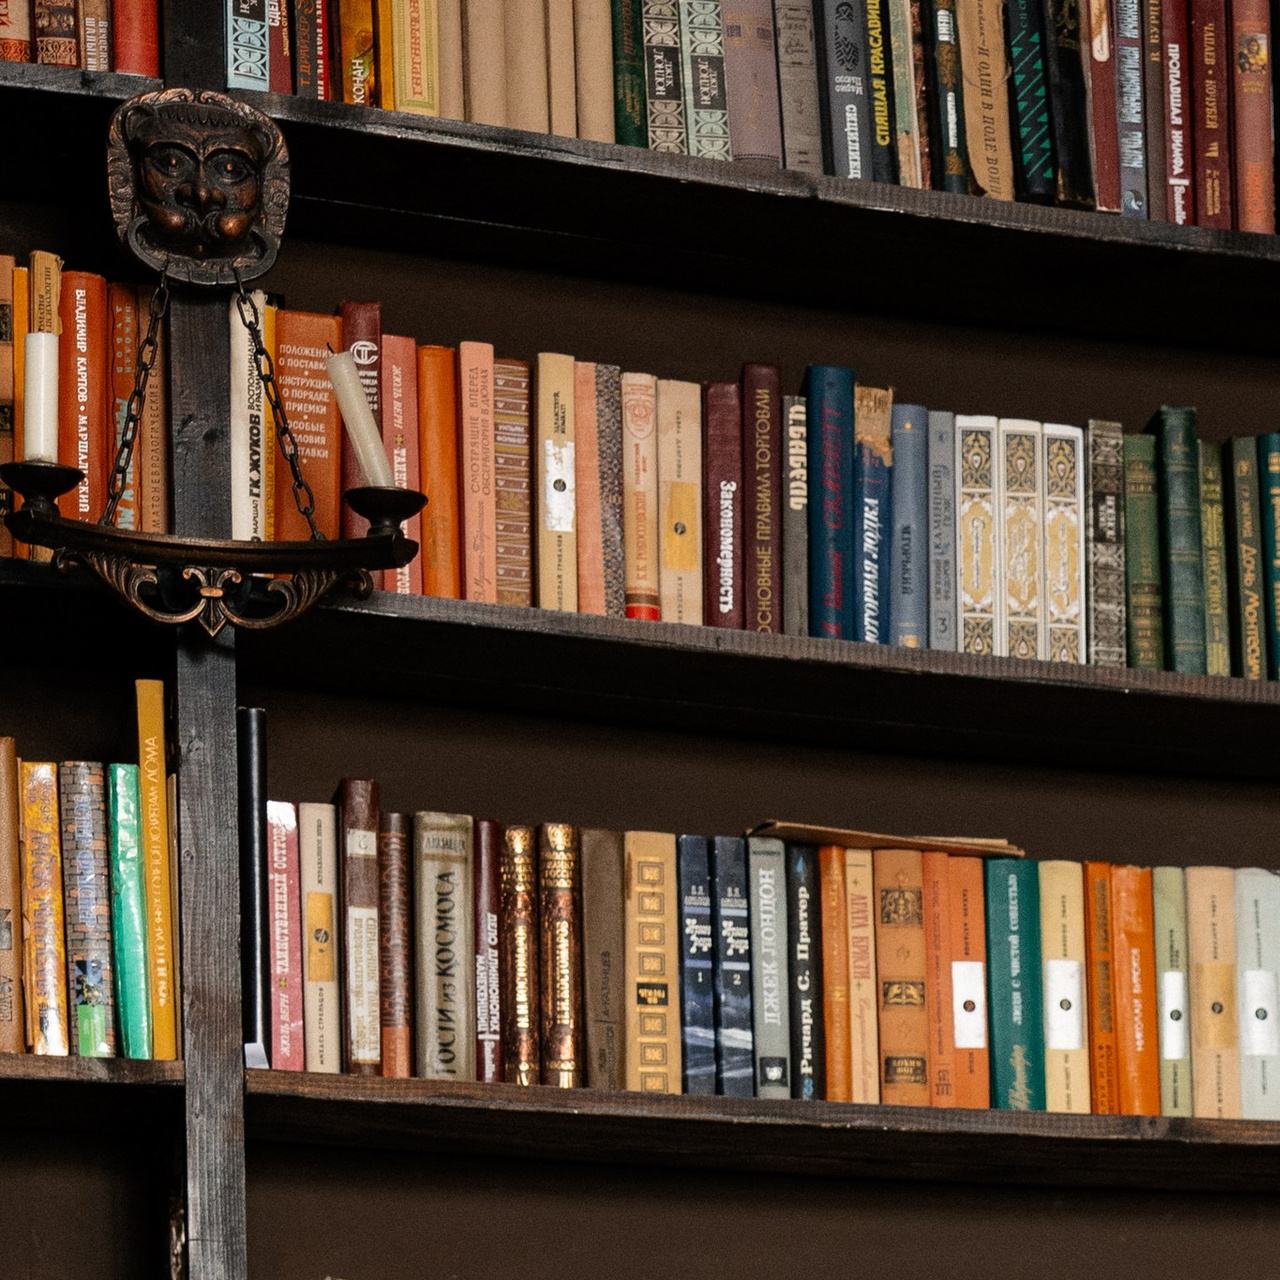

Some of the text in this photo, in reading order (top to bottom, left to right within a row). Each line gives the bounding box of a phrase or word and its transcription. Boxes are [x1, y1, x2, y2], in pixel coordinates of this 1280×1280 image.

[351, 58, 365, 103] КОНАН
[866, 0, 889, 146] СПЯЩАЯ КРАСАВИЦ
[978, 61, 992, 97] ОДИН
[1167, 43, 1184, 175] ПРОПАВШАЯ НИМФА
[1203, 24, 1218, 129] ЧАПАЕВ КОЧУБЕЙ
[983, 115, 996, 151] ПОЛЕ
[75, 288, 86, 352] ВЛАДИМИР
[279, 344, 338, 359] ПОЛОЖЕНИ
[76, 355, 88, 402] КАРПОВ
[278, 375, 334, 390] ИНСТРУКЦИИ
[287, 358, 327, 370] ПОСТАВК
[291, 389, 330, 402] ПОРЯДКЕ
[285, 401, 327, 414] ПРИЕМКИ
[469, 366, 480, 493] СМОТРЯЩИЕ ВПЕРЕД
[149, 383, 161, 529] МАТОНЕВРОЛОГИЧЕСКИЕ
[718, 479, 737, 613] Закономерность
[754, 388, 773, 633] ОСНОВНЫЕ ПРАВИЛА ТОРГОВЛИ
[863, 497, 883, 558] ЛОДКА
[434, 869, 457, 977] КОСМОСА
[758, 867, 781, 1026] ДЖЕК ЛОНДОН
[795, 885, 810, 961] Пратер
[850, 892, 868, 930] АГАТА
[279, 992, 290, 1021] ВЕРН
[365, 917, 379, 1052] СПРАВОЧНИК ТОВАРОВЕДА
[475, 955, 489, 1032] МАНЕКЕНЩИЦ
[486, 912, 500, 1032] ДЕЛО ДЛИННОНОГИХ
[434, 1007, 457, 1076] ГОСТИ
[798, 998, 814, 1075] Ричард
